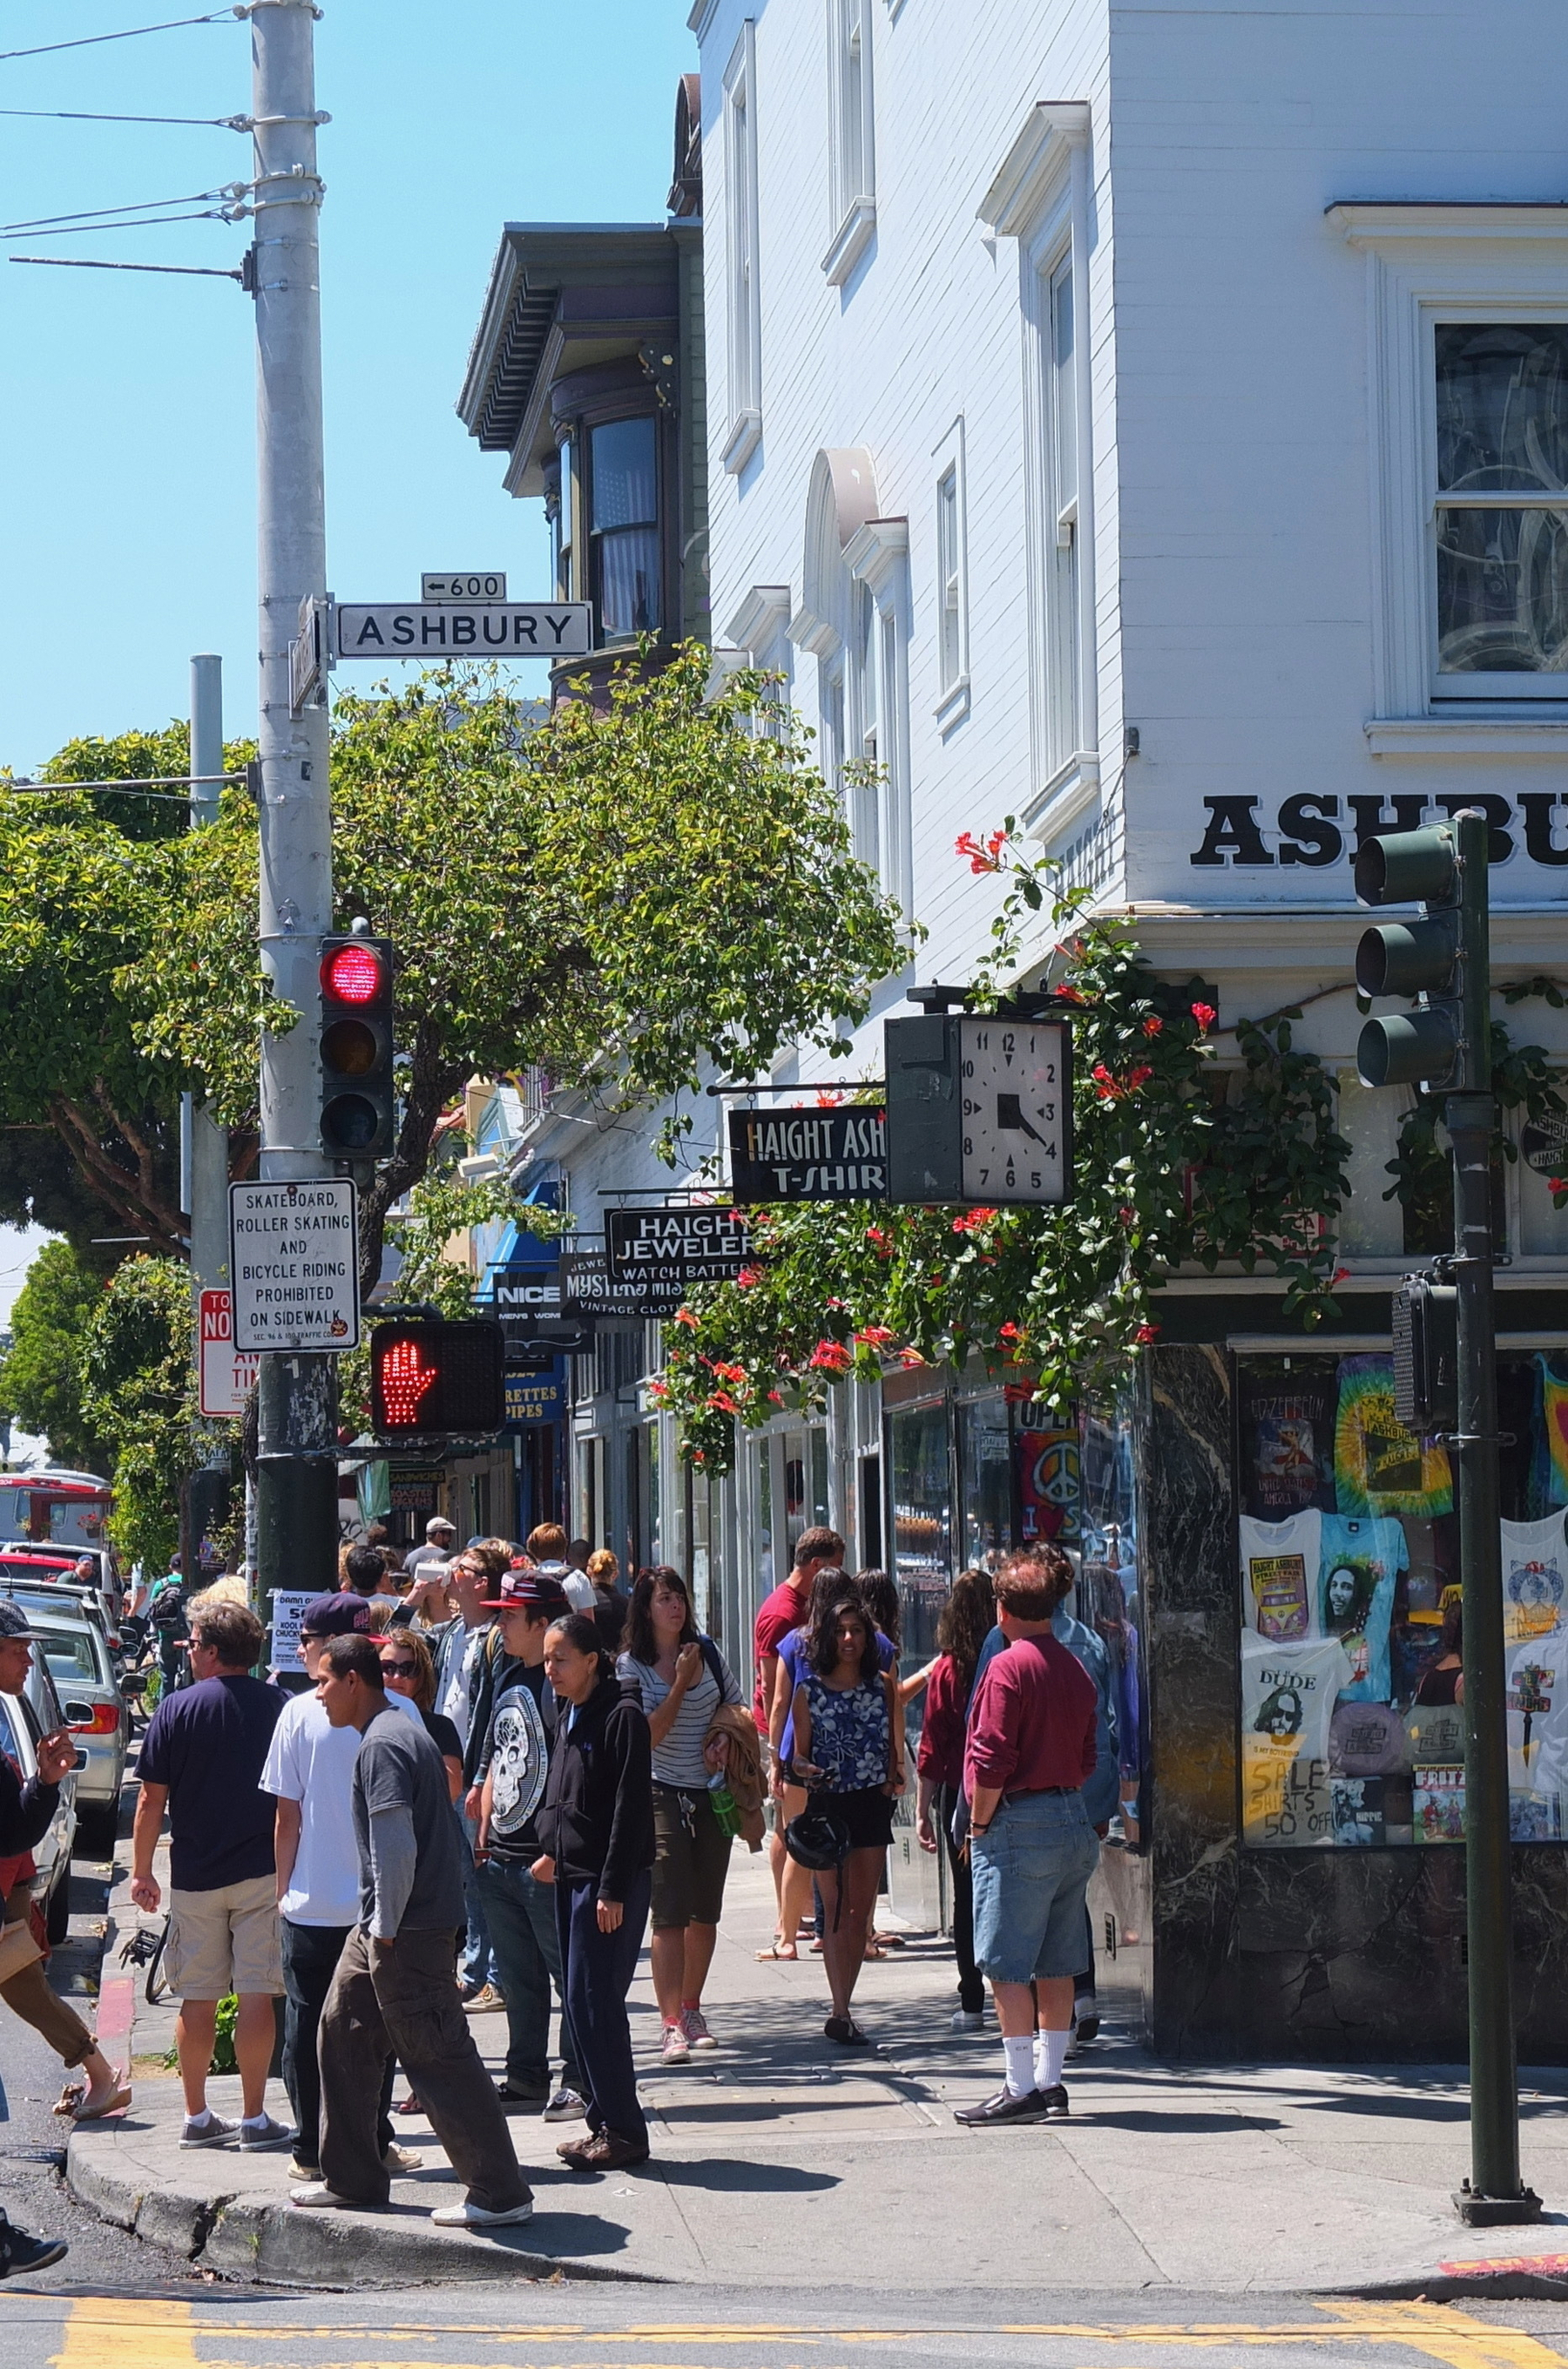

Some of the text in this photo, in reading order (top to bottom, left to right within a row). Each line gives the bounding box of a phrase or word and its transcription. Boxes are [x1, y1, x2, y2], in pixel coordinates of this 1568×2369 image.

[450, 577, 498, 596] 600
[356, 615, 571, 646] ASHBURY
[977, 1032, 988, 1050] 11
[1003, 1033, 1015, 1052] 12
[1030, 1036, 1035, 1053] 1
[962, 1060, 974, 1078] 10
[1046, 1065, 1055, 1083] 2
[963, 1099, 973, 1116] 9
[1045, 1104, 1055, 1121] 3
[747, 1118, 886, 1161] HAIGHT ASH
[963, 1137, 973, 1155] 8
[1045, 1141, 1057, 1160] 4
[979, 1169, 990, 1185] 7
[1005, 1171, 1016, 1187] 6
[1031, 1173, 1042, 1188] 5
[246, 1192, 339, 1209] SKATEBOARD,
[236, 1215, 350, 1233] ROLLER SKATING
[280, 1241, 308, 1255] AND
[242, 1262, 346, 1280] BICYCLE RIDING
[622, 1266, 680, 1281] WATCH
[255, 1287, 334, 1303] PROHIBITED
[497, 1286, 560, 1304] NICE
[579, 1301, 635, 1315] VINTAGE
[204, 1311, 230, 1338] NO
[250, 1310, 341, 1327] ON SIDEWALK
[505, 1404, 544, 1418] PIPES
[1024, 1506, 1038, 1534] I
[1259, 1670, 1317, 1690] DUDE
[1250, 1759, 1326, 1794] SALE
[1249, 1791, 1315, 1815] SHIRTS
[1308, 1811, 1332, 1832] OFF
[1355, 1811, 1382, 1823] HIPPIE
